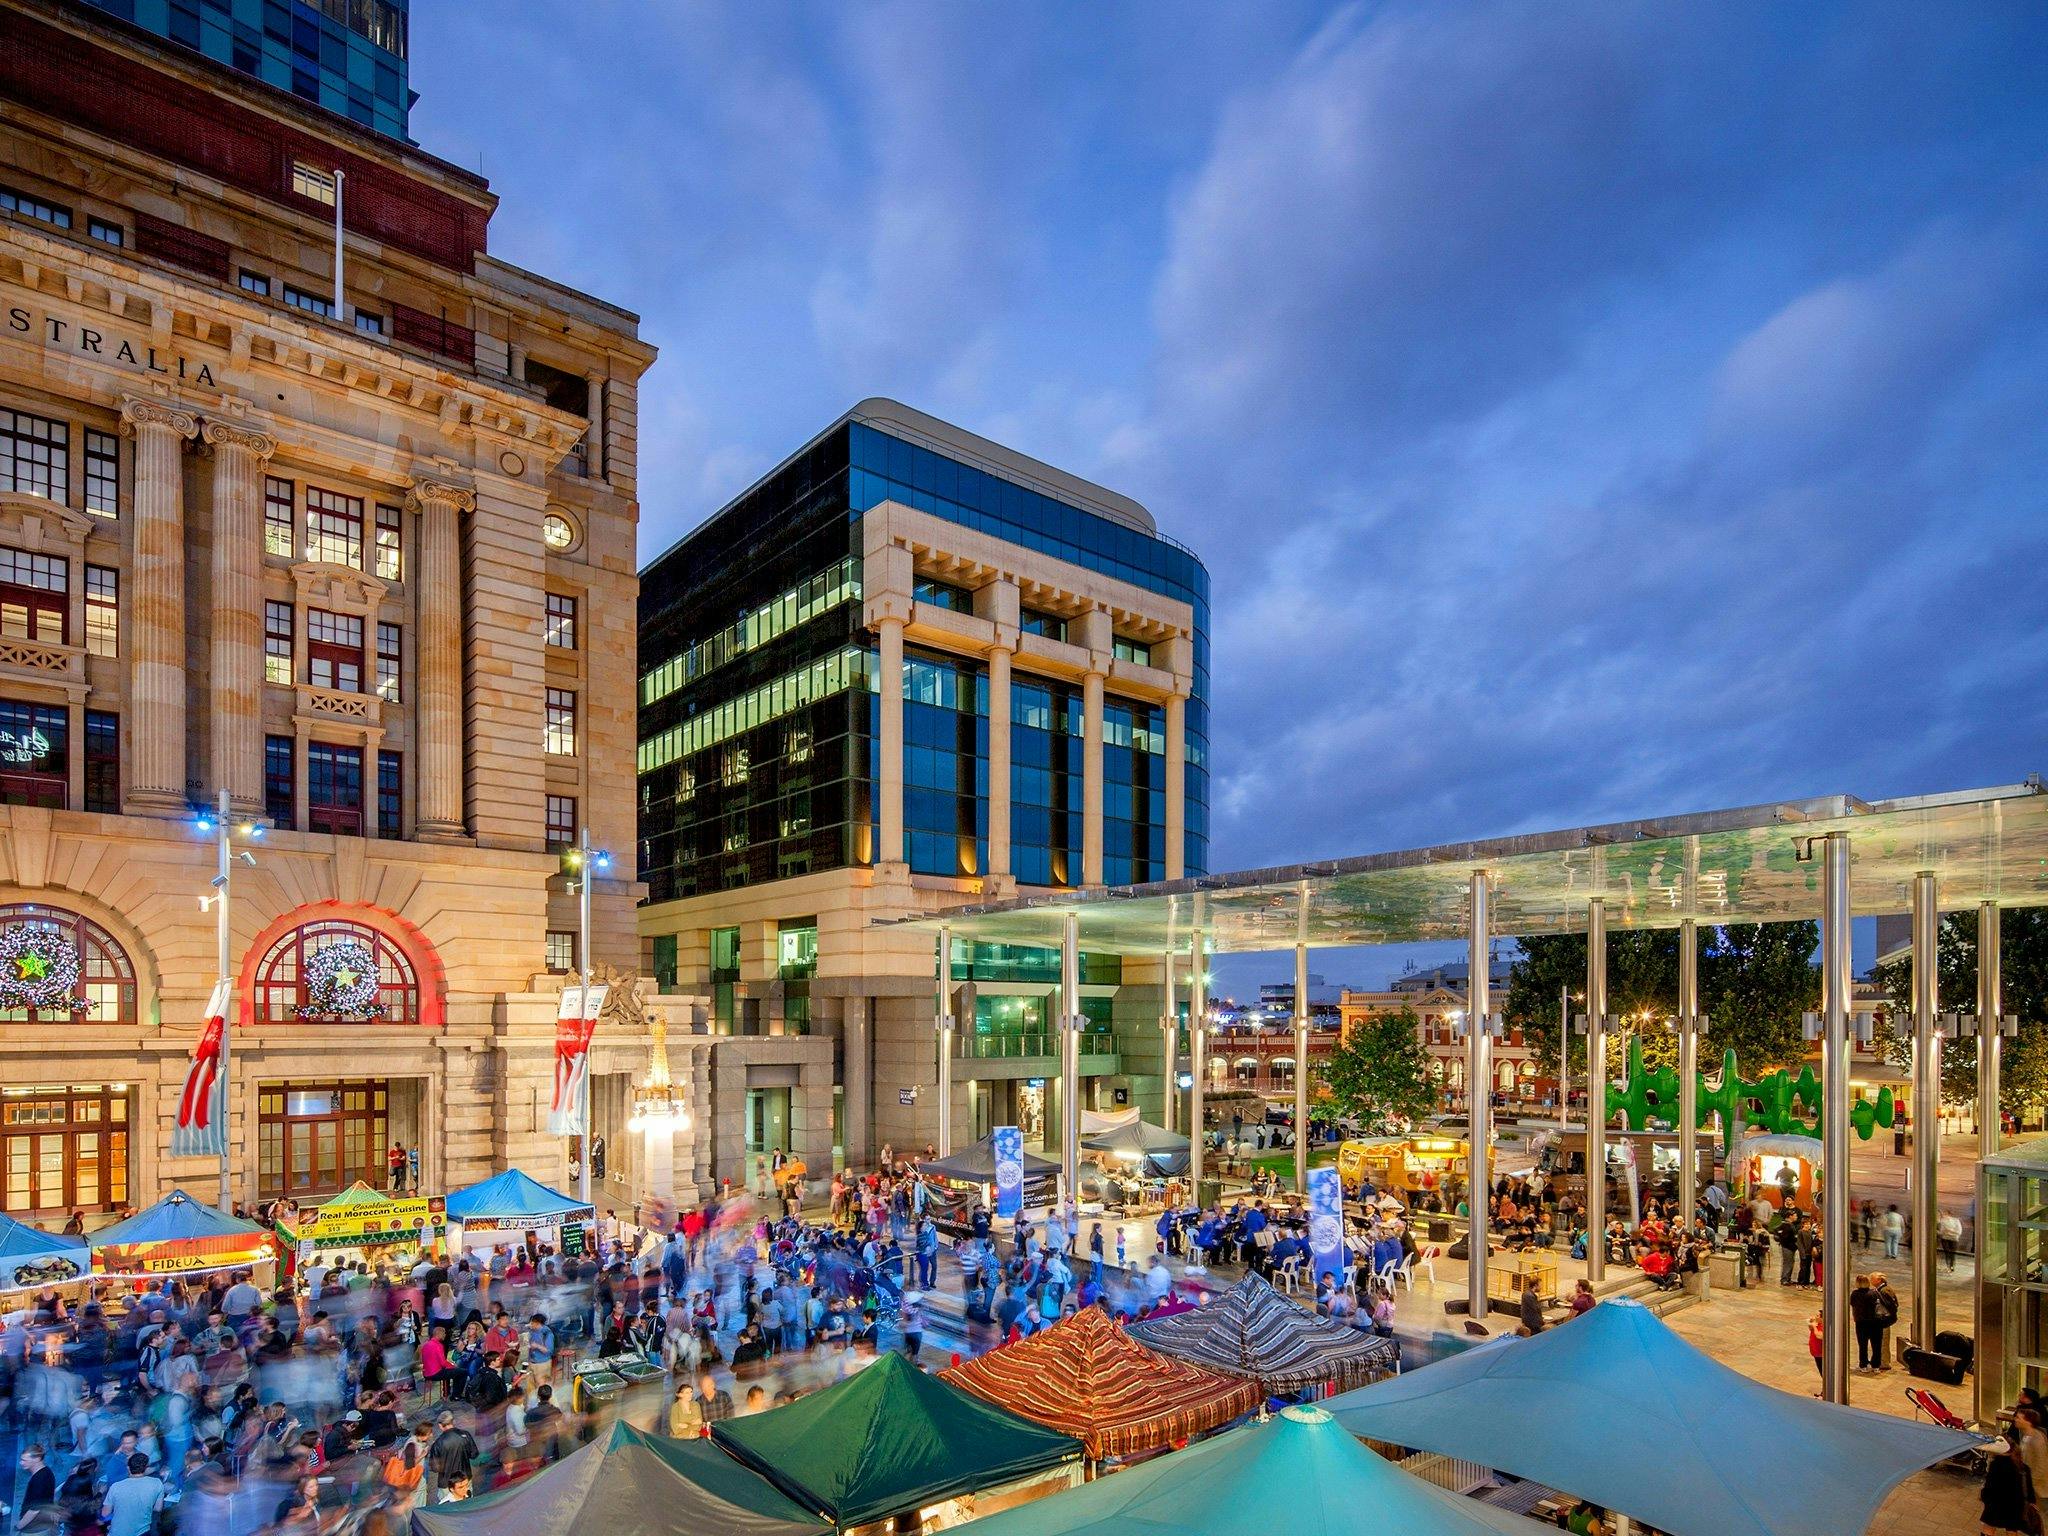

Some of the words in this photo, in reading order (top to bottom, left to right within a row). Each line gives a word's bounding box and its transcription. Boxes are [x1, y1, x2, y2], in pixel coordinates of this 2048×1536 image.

[9, 308, 216, 387] STRALIA
[320, 1212, 342, 1220] Real
[344, 1208, 390, 1218] Moroccan
[393, 1205, 427, 1214] Cuisine
[546, 1214, 564, 1224] FOOD
